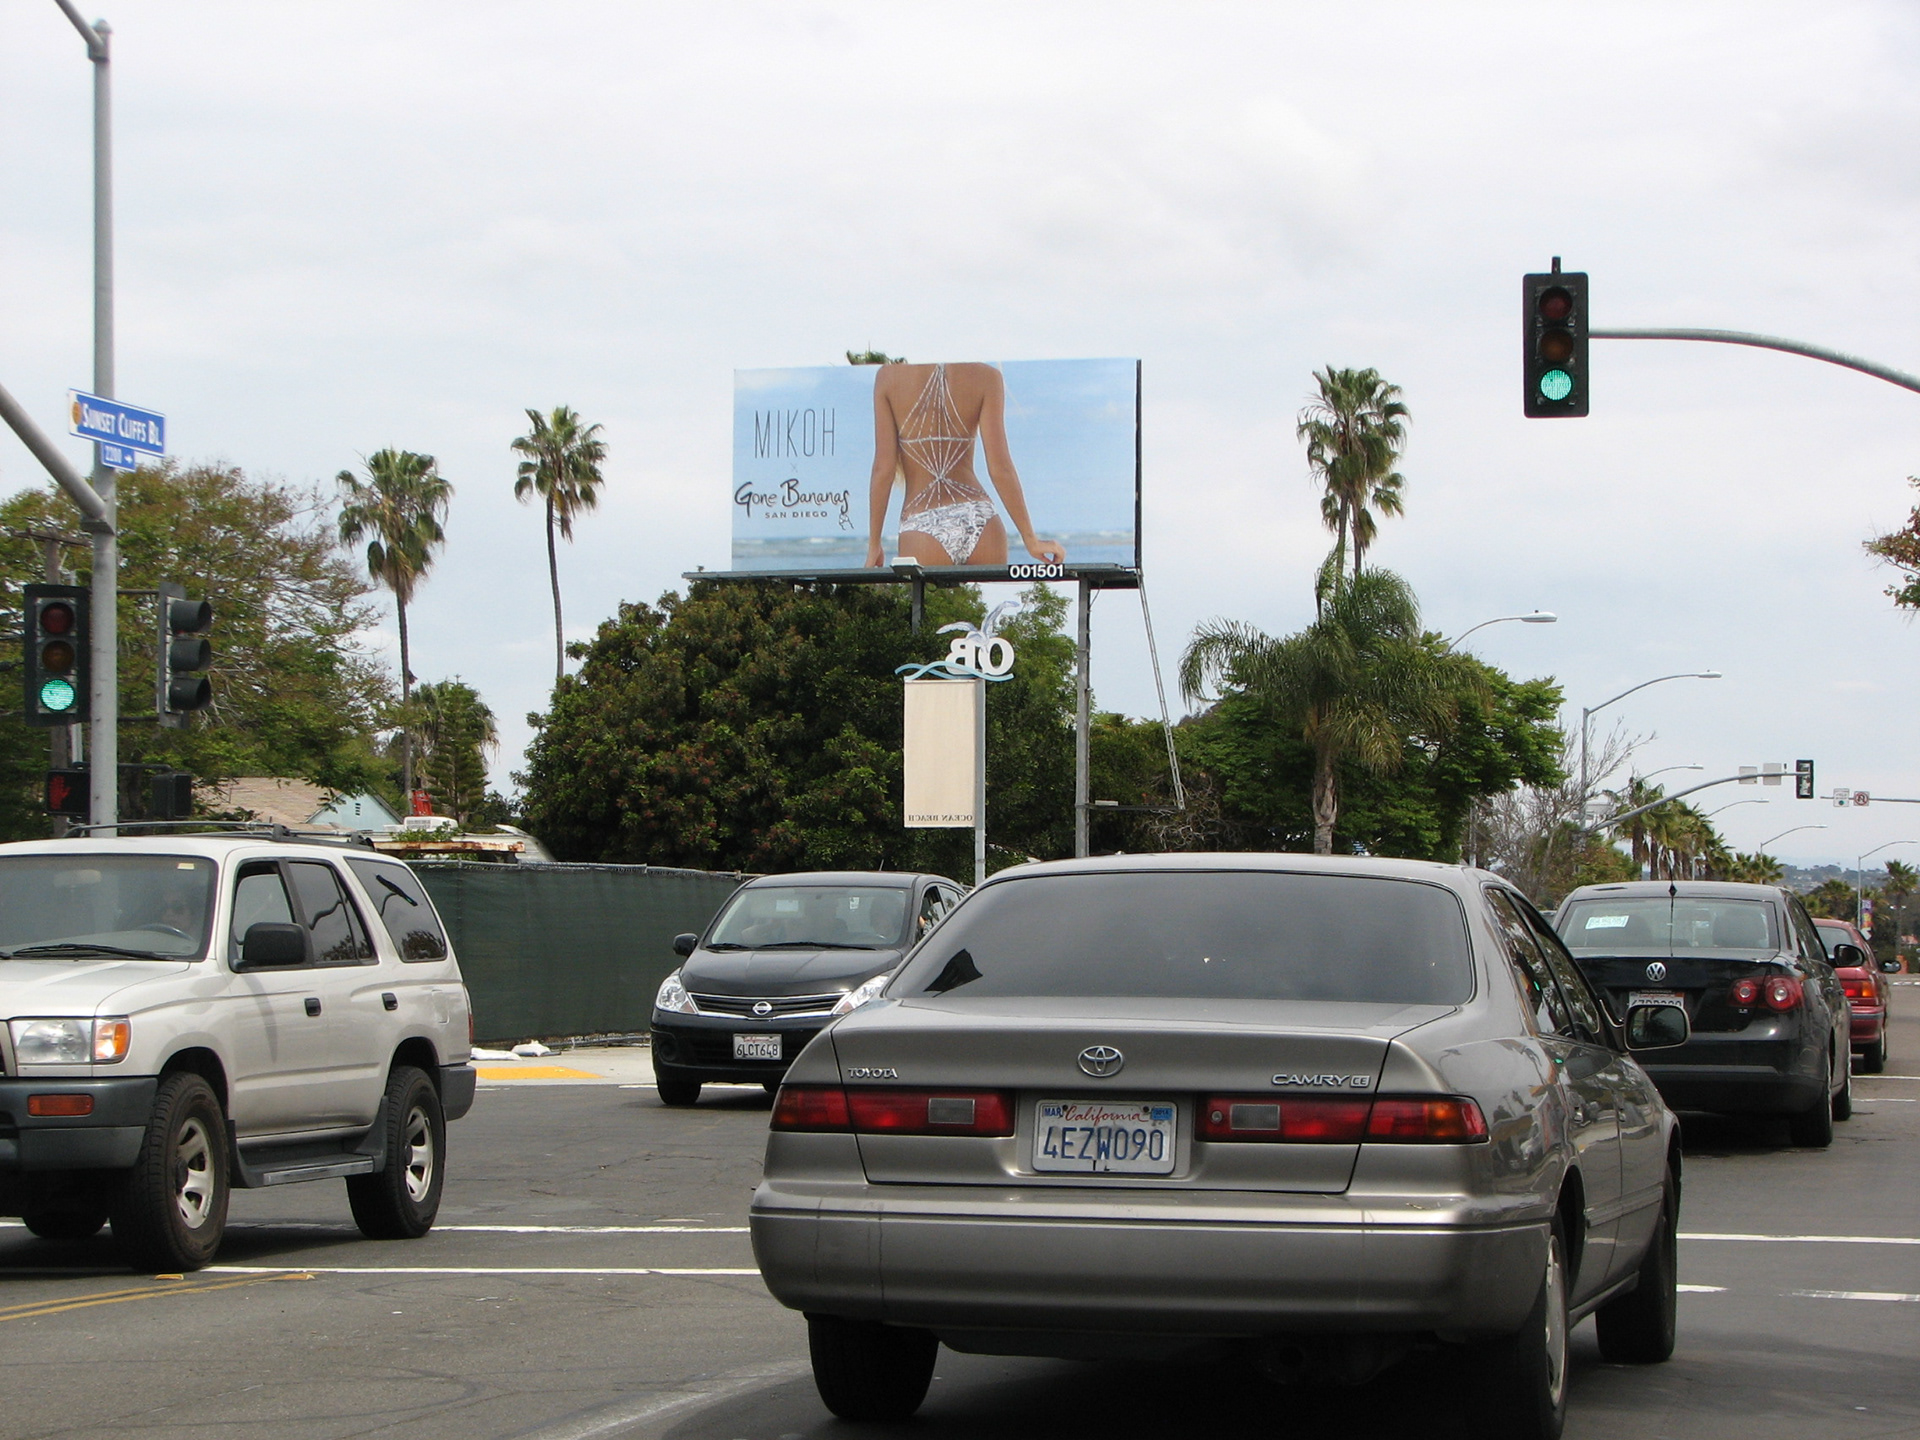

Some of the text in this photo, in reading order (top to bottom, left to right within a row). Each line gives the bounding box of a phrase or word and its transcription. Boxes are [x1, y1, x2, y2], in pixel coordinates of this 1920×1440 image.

[119, 412, 147, 443] CLIFFS
[754, 408, 835, 459] MIKOH
[734, 478, 849, 518] Gone Bananas
[765, 510, 828, 519] SAN DIEGO
[1009, 564, 1064, 579] 001501
[736, 1043, 779, 1057] 6LCT648
[848, 1067, 898, 1079] TOYOTA
[1272, 1073, 1350, 1087] CAMRY
[1044, 1107, 1063, 1117] MAR
[1065, 1105, 1149, 1127] California
[1043, 1126, 1164, 1161] 4EZW090
